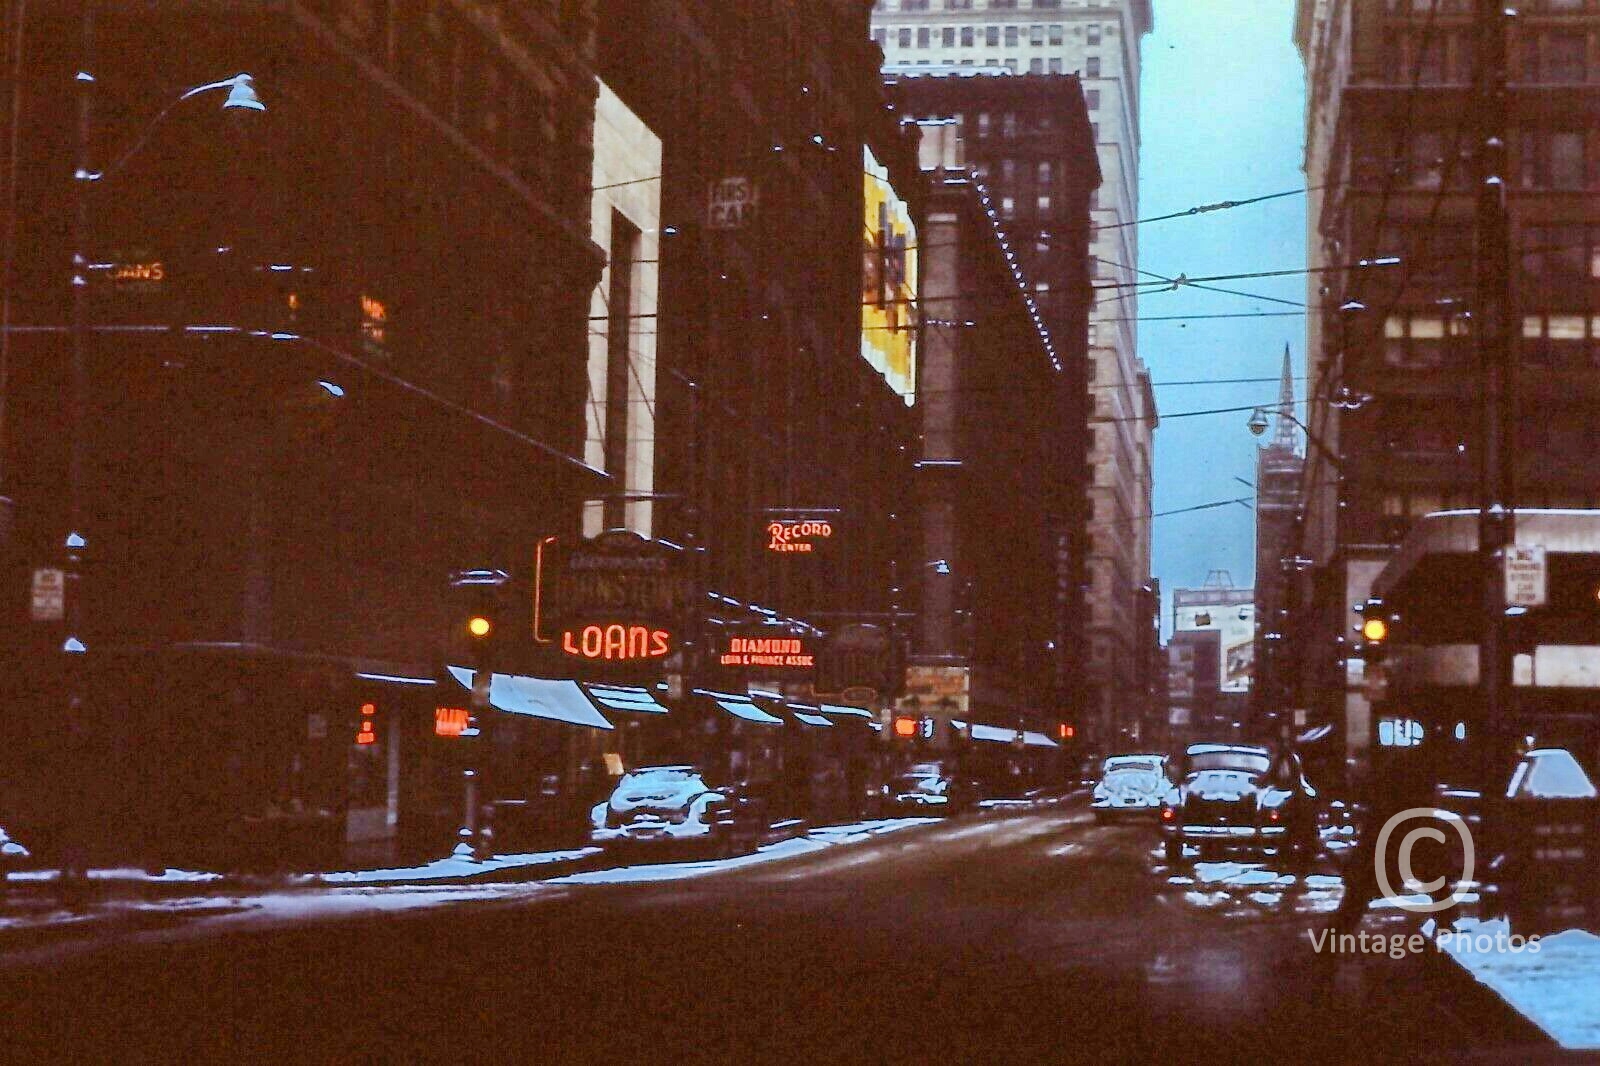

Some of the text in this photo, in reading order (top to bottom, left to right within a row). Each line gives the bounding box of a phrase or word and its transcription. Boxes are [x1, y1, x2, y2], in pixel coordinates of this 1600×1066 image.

[767, 522, 832, 549] RECORD
[775, 543, 812, 553] CENTER
[563, 623, 670, 660] LOANS
[730, 638, 802, 654] DIAMOND
